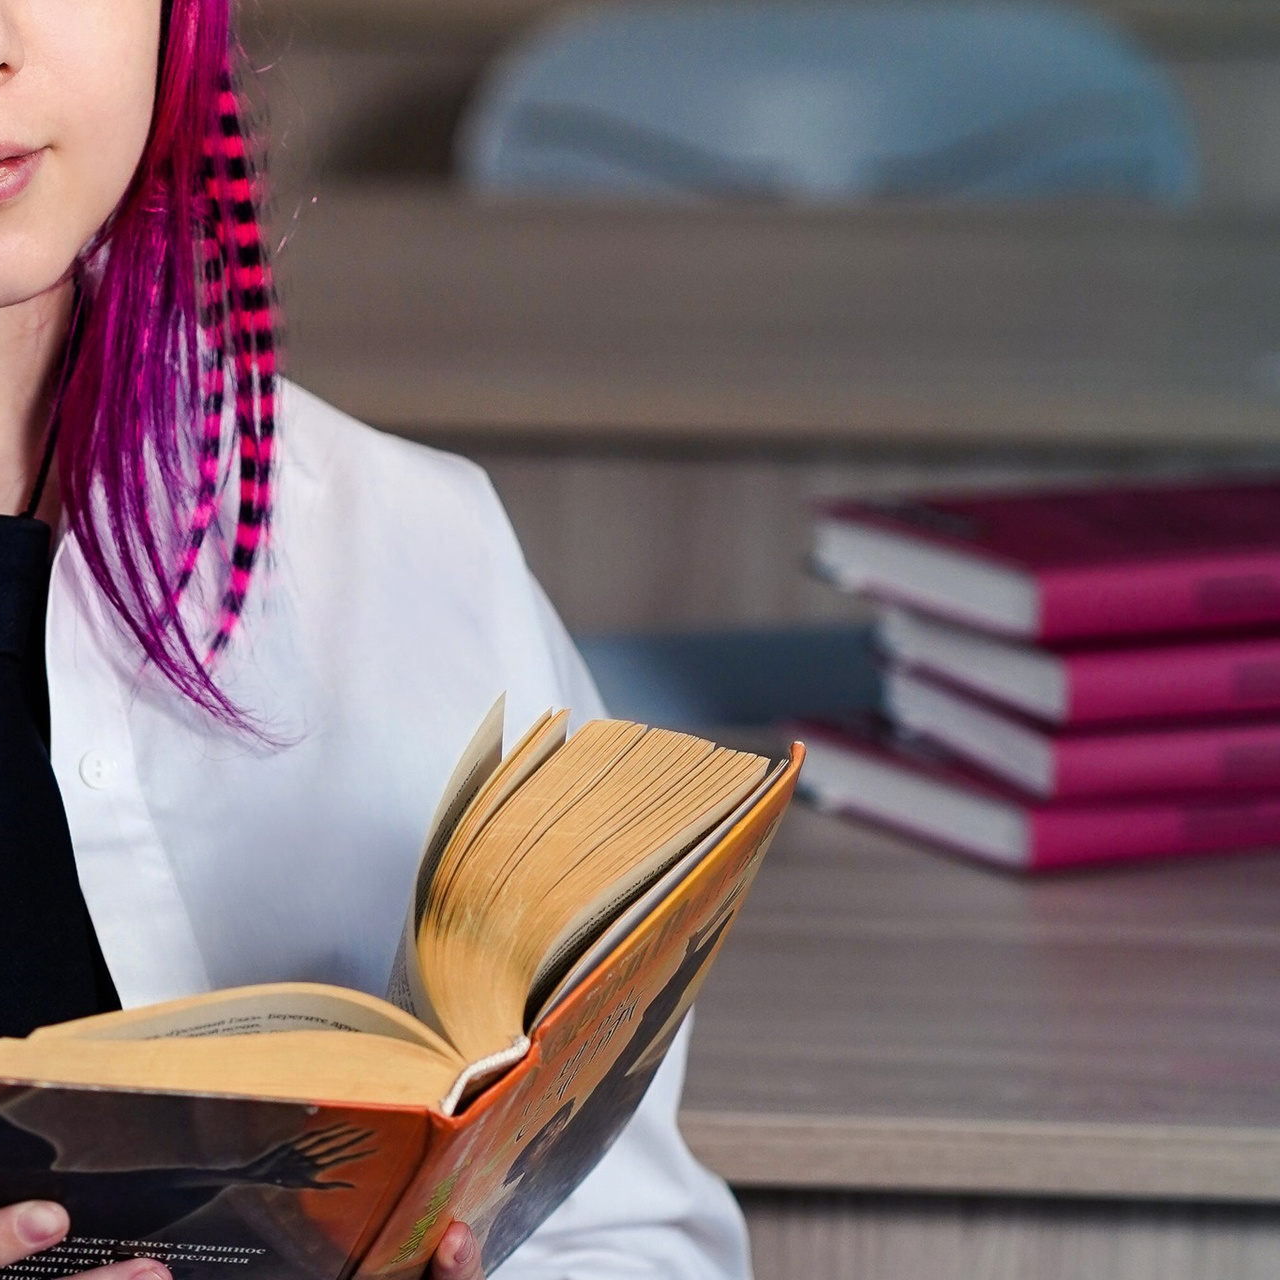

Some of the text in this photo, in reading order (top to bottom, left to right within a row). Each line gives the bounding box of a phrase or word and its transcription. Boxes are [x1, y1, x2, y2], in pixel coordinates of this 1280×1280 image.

[71, 1236, 118, 1246] ждет
[120, 1239, 174, 1250] самое
[176, 1242, 267, 1256] страшное
[133, 1250, 250, 1265] смертельная
[1, 1264, 58, 1274] мощи
